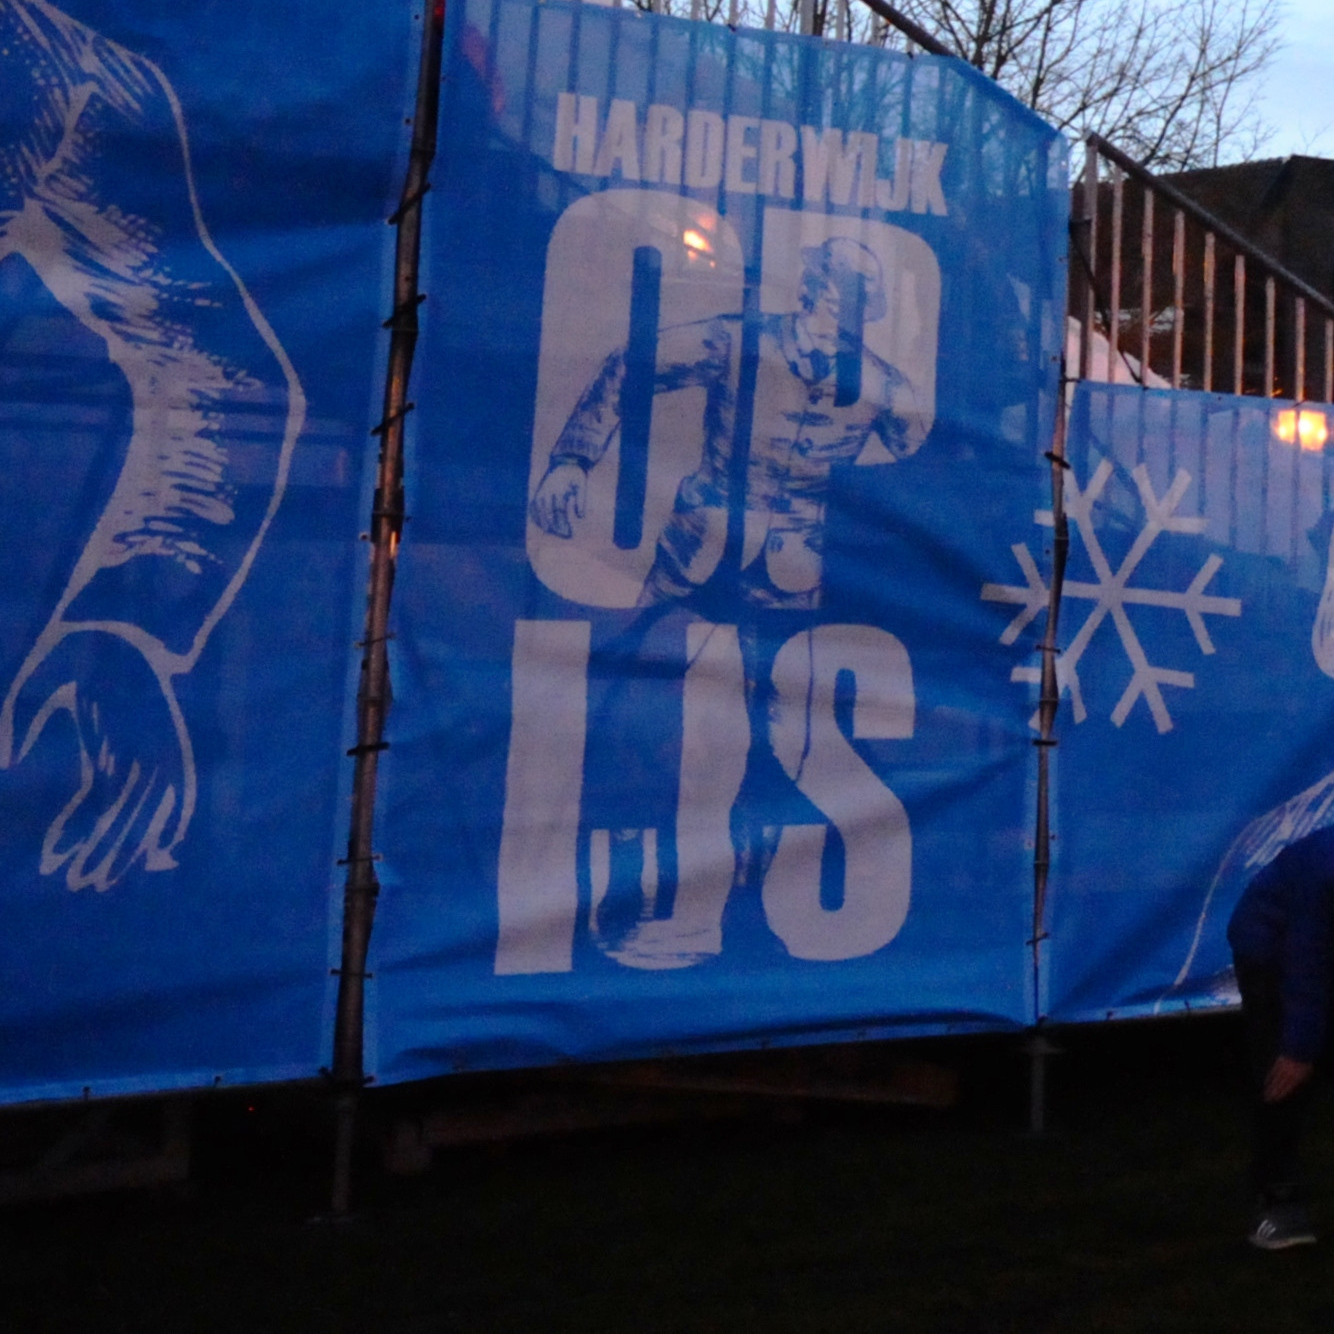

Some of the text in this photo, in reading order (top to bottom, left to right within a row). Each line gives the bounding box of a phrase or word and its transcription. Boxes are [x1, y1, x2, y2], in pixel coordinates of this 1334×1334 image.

[553, 92, 949, 216] HARDERWIJK
[526, 187, 942, 609] OP
[494, 619, 916, 975] IJS
